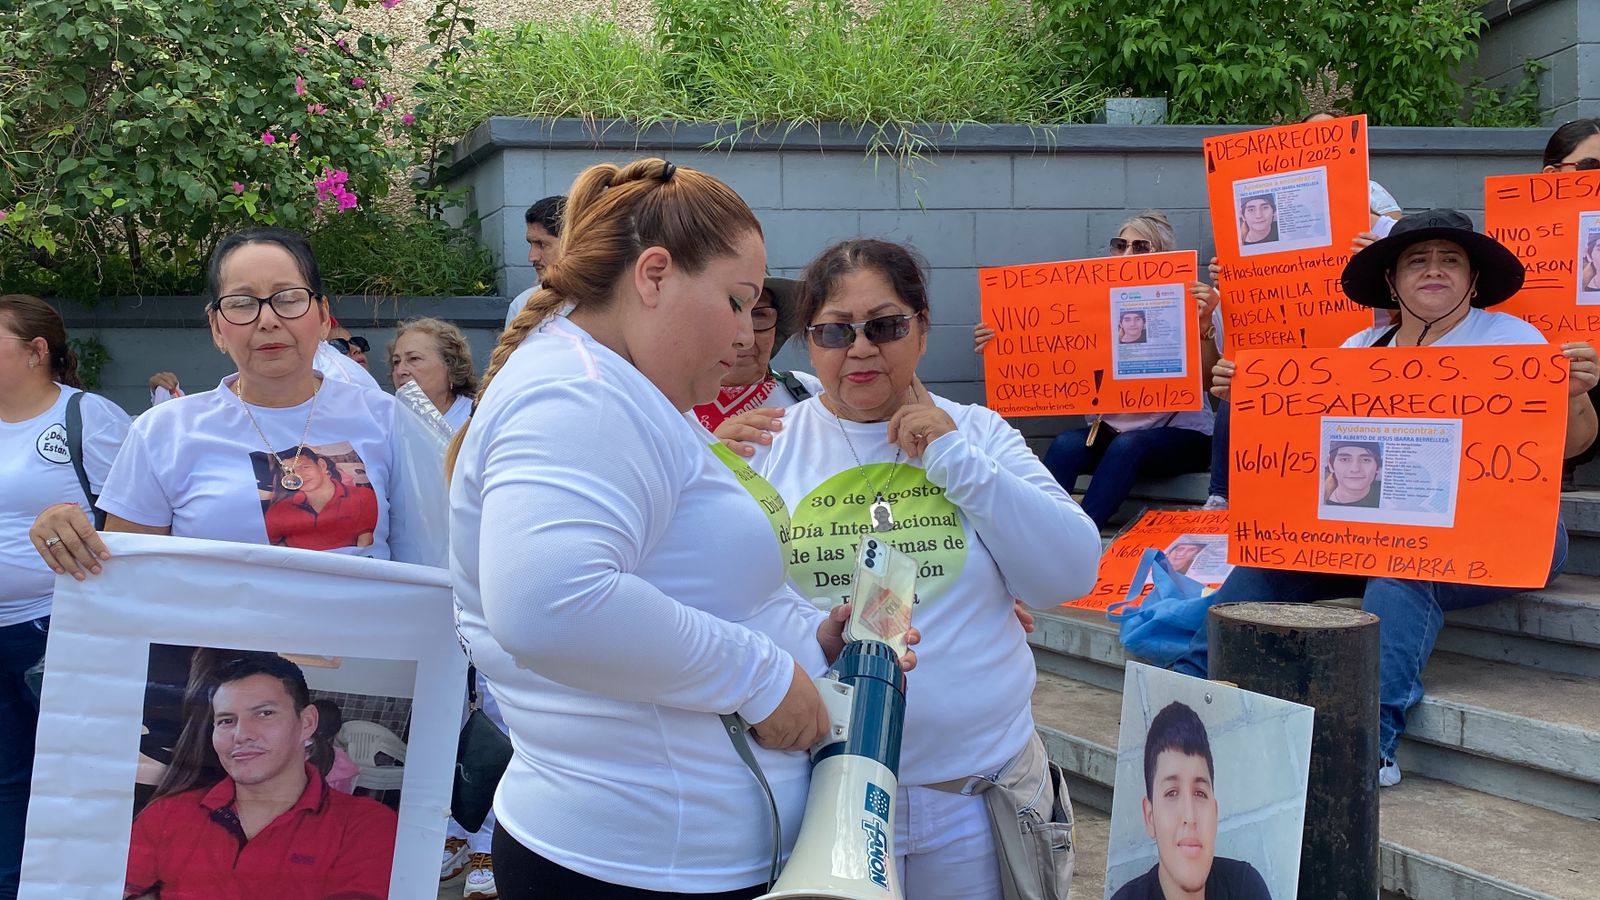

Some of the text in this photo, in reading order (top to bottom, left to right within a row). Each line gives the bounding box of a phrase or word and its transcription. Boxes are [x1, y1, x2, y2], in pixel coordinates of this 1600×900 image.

[1257, 146, 1341, 173] 16/01/2025
[1488, 223, 1564, 243] VIVO SE
[1516, 245, 1537, 258] LO
[1222, 252, 1349, 282] #hastaencontrartein
[1524, 259, 1574, 275] ARON
[1228, 290, 1245, 304] TU
[1250, 282, 1312, 303] FAMILIA
[992, 303, 1080, 333] VIVO SE
[1295, 301, 1315, 318] TU
[996, 337, 1014, 356] LO
[1020, 333, 1097, 354] LLEVARON
[1230, 333, 1245, 348] TE
[998, 359, 1076, 380] VIVO LO
[1119, 383, 1195, 409] 16/01/25
[1392, 426, 1436, 435] encontrar
[1235, 442, 1317, 478] 16/01/25
[1465, 441, 1548, 483] S.O.S.
[811, 494, 836, 508] 30
[842, 492, 865, 505] de
[791, 512, 958, 541] Día Interacional
[790, 550, 810, 565] de
[817, 545, 845, 562] las
[943, 535, 965, 550] de
[1239, 546, 1285, 564] INES
[1293, 549, 1377, 570] ALBERTO
[1388, 555, 1456, 577] IBARRA
[1468, 561, 1493, 579] B.
[862, 818, 890, 891] FANON
